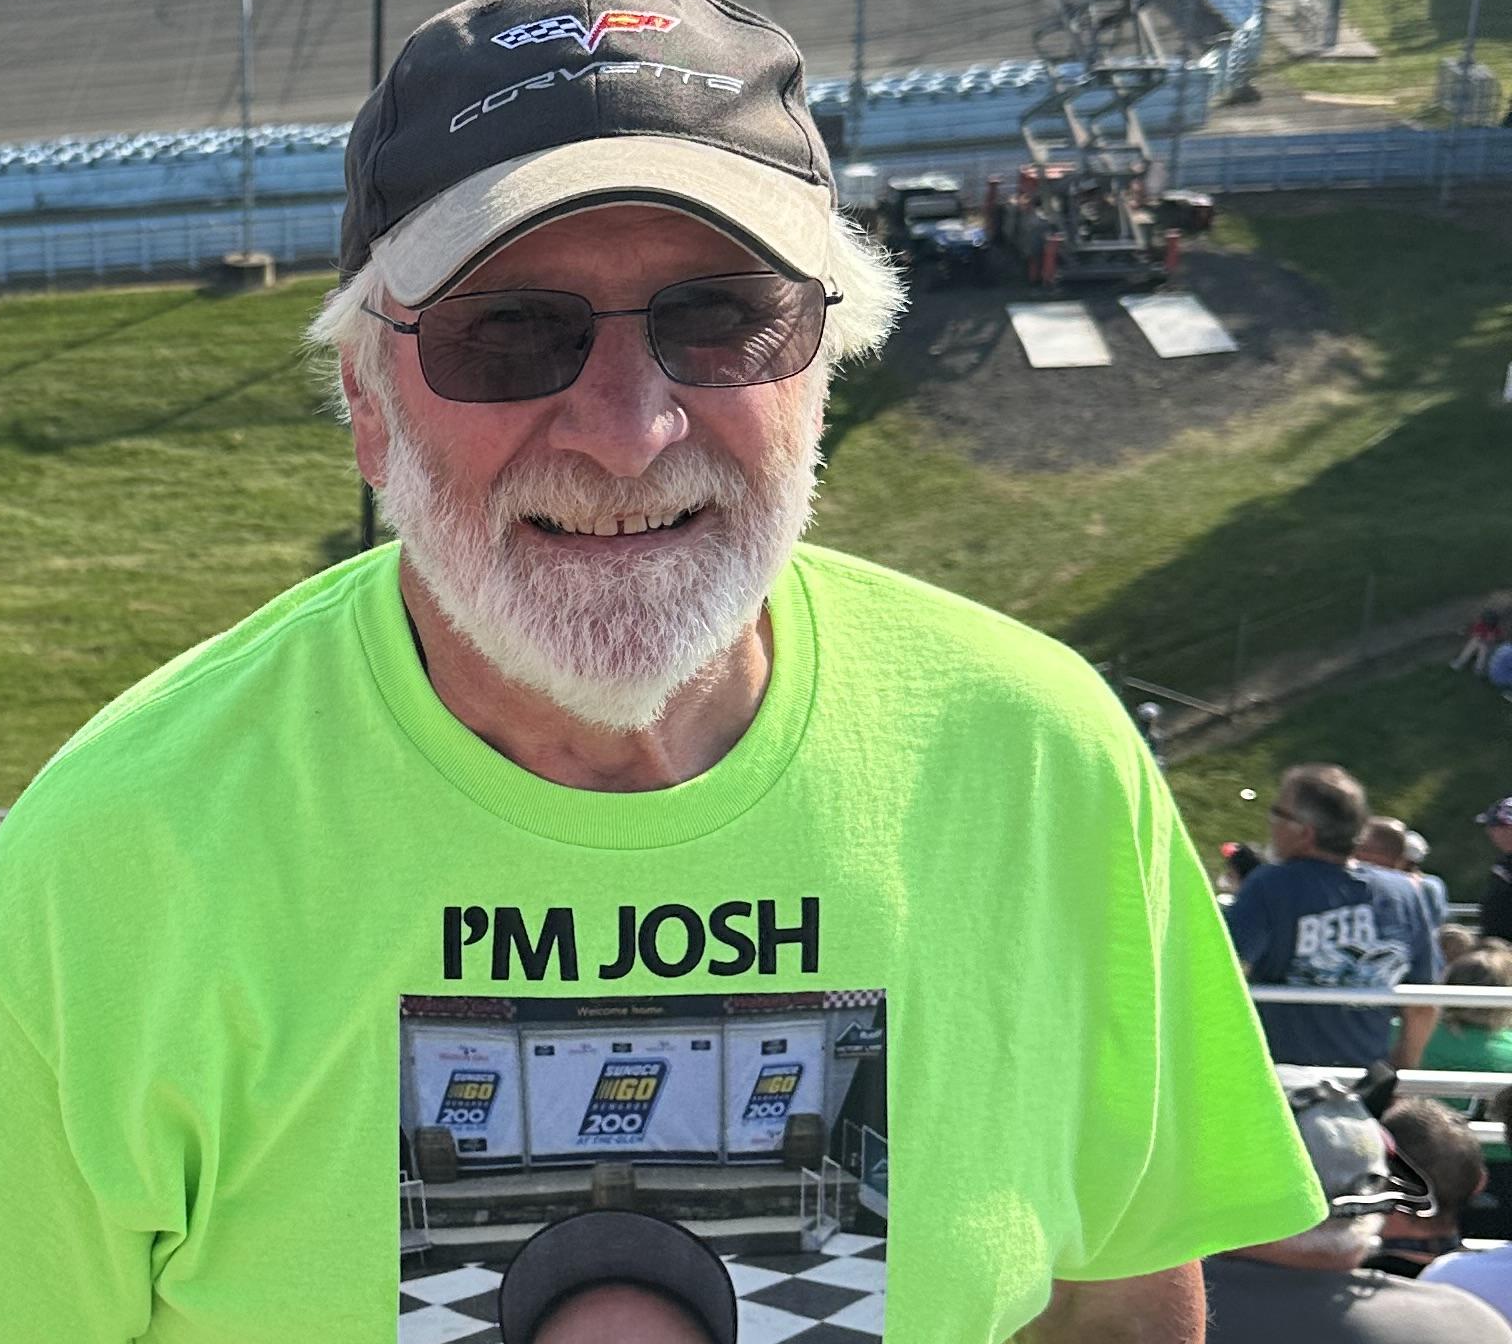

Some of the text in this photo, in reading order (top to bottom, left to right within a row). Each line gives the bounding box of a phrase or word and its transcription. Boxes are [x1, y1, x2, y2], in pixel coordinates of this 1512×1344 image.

[449, 60, 745, 134] CORVETTE
[444, 896, 820, 982] I'M JOSH
[604, 1064, 662, 1076] SUNOCO
[463, 1083, 494, 1099] GO
[614, 1077, 658, 1101] GO
[441, 1108, 485, 1123] 200
[747, 1102, 786, 1118] 200
[585, 1113, 643, 1133] 200
